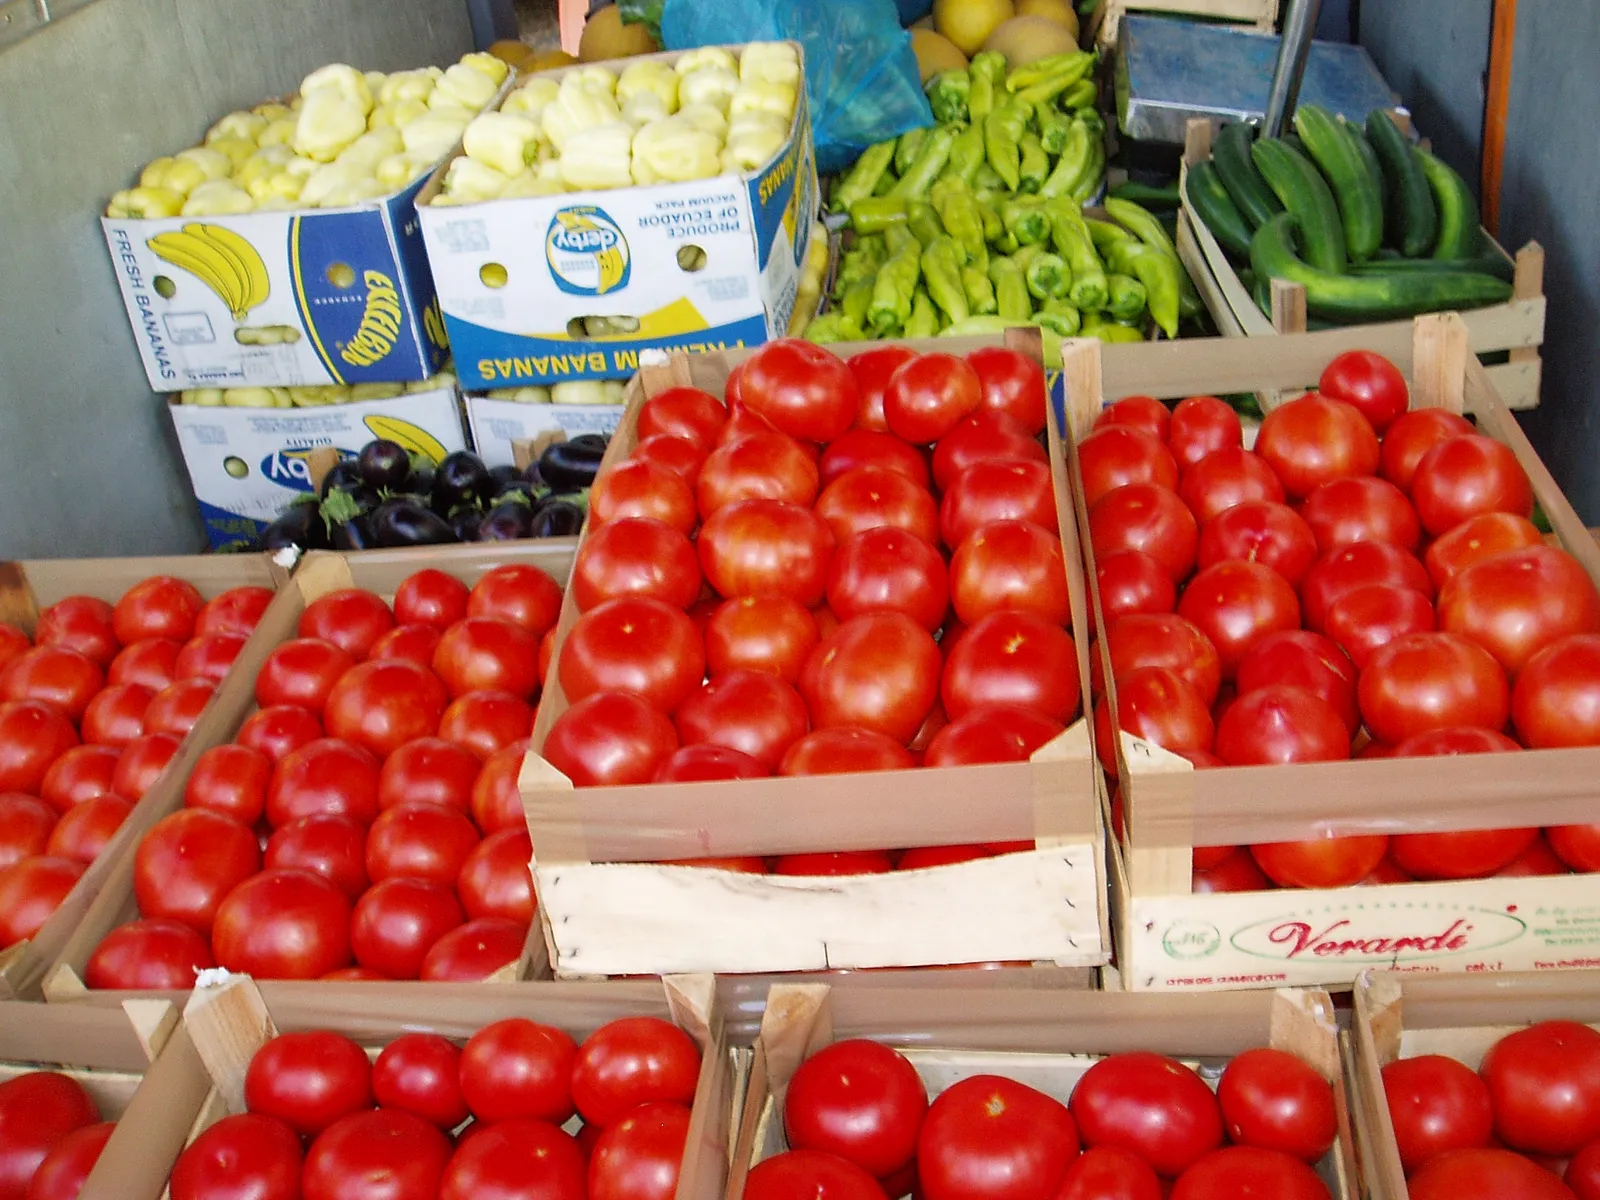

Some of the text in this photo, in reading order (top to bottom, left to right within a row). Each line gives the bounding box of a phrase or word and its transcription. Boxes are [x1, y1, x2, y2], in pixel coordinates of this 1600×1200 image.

[655, 193, 736, 210] VACUUM PACK
[638, 207, 738, 228] OF ECUADOR
[666, 220, 740, 238] PRODUCE
[556, 222, 615, 254] derby
[112, 228, 177, 381] FRESH BANANAS
[478, 351, 607, 380] BANANAS
[286, 437, 332, 447] QUALITY
[1268, 918, 1474, 959] Verardi
